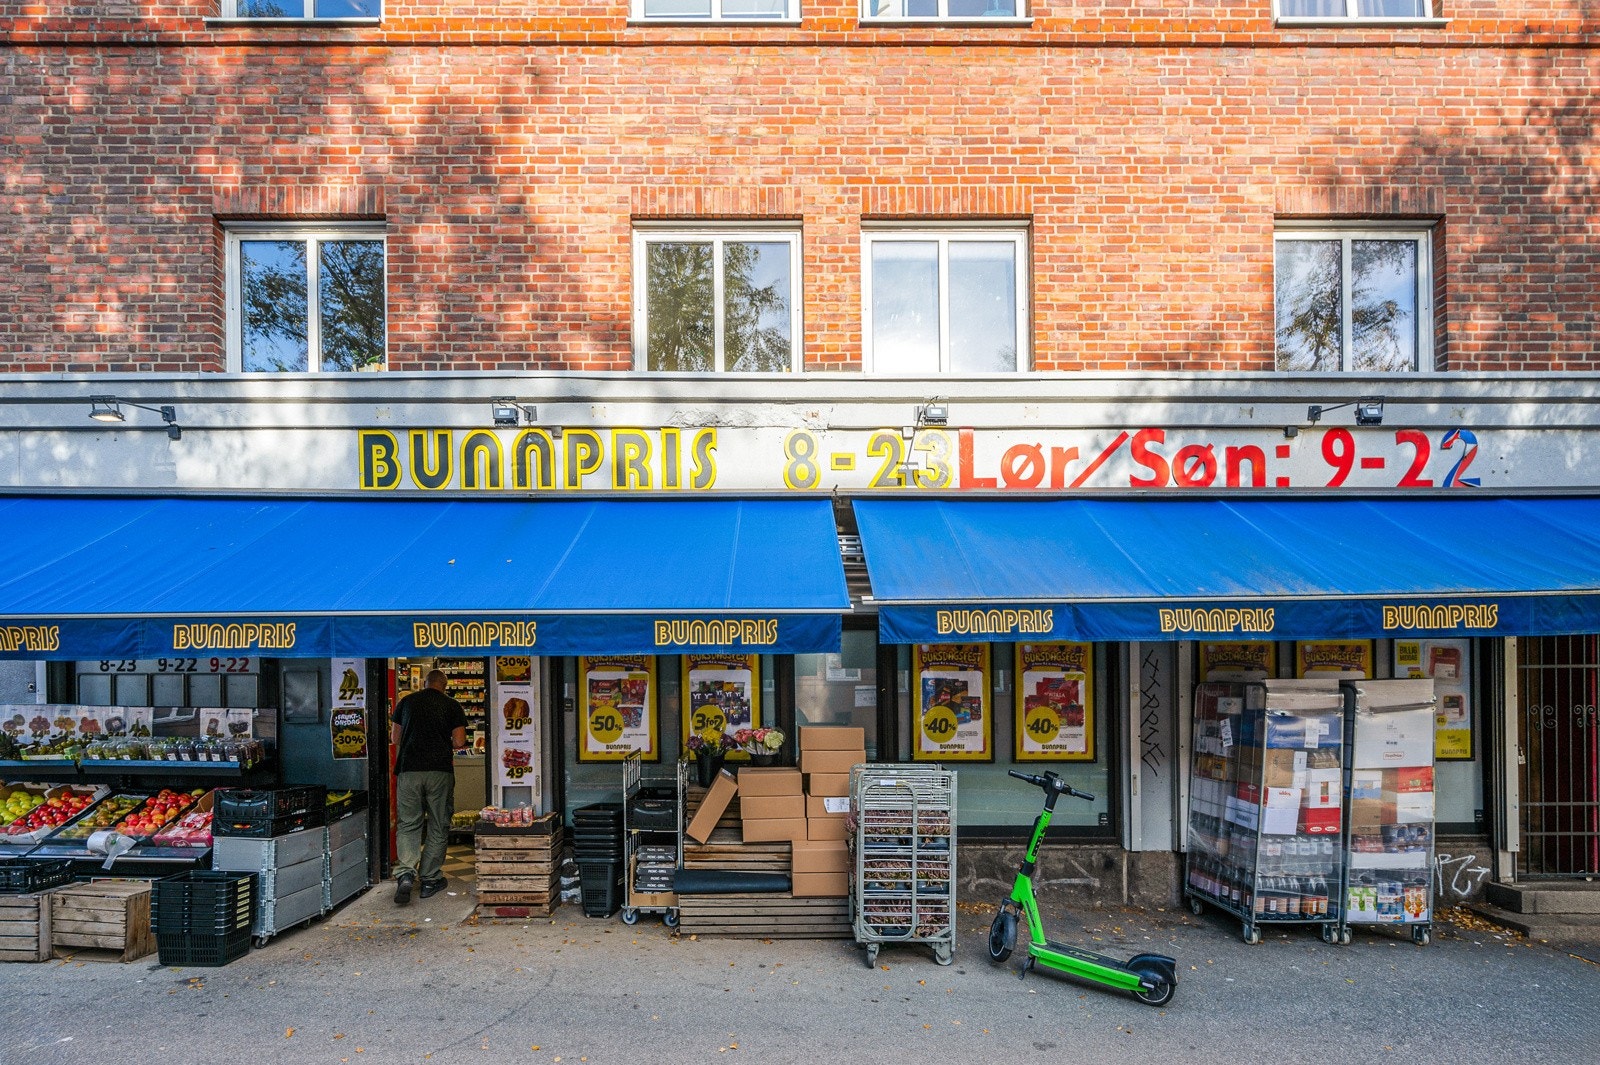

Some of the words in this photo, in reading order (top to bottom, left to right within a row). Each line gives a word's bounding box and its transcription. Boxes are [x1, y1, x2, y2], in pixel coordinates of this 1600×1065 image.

[358, 428, 717, 489] BUNNPRIS
[958, 426, 1290, 488] Lør/Søn:
[1320, 428, 1482, 488] 9-22
[937, 609, 1053, 635] BUNNPRIS
[1159, 608, 1275, 633] BUNNPRIS
[1383, 604, 1499, 630] BUNNPRIS
[173, 623, 296, 649] BUNNPRIS
[413, 621, 537, 648] BUNNPRIS
[654, 619, 778, 645] BUNNPRIS
[100, 658, 137, 672] 8-23
[157, 658, 197, 672] 9-22
[209, 657, 250, 673] 9-22
[499, 657, 528, 667] -30%
[591, 715, 623, 731] -50%
[694, 713, 706, 730] 3
[925, 718, 956, 733] -40%
[1027, 718, 1058, 734] -40%
[335, 735, 364, 745] -30%
